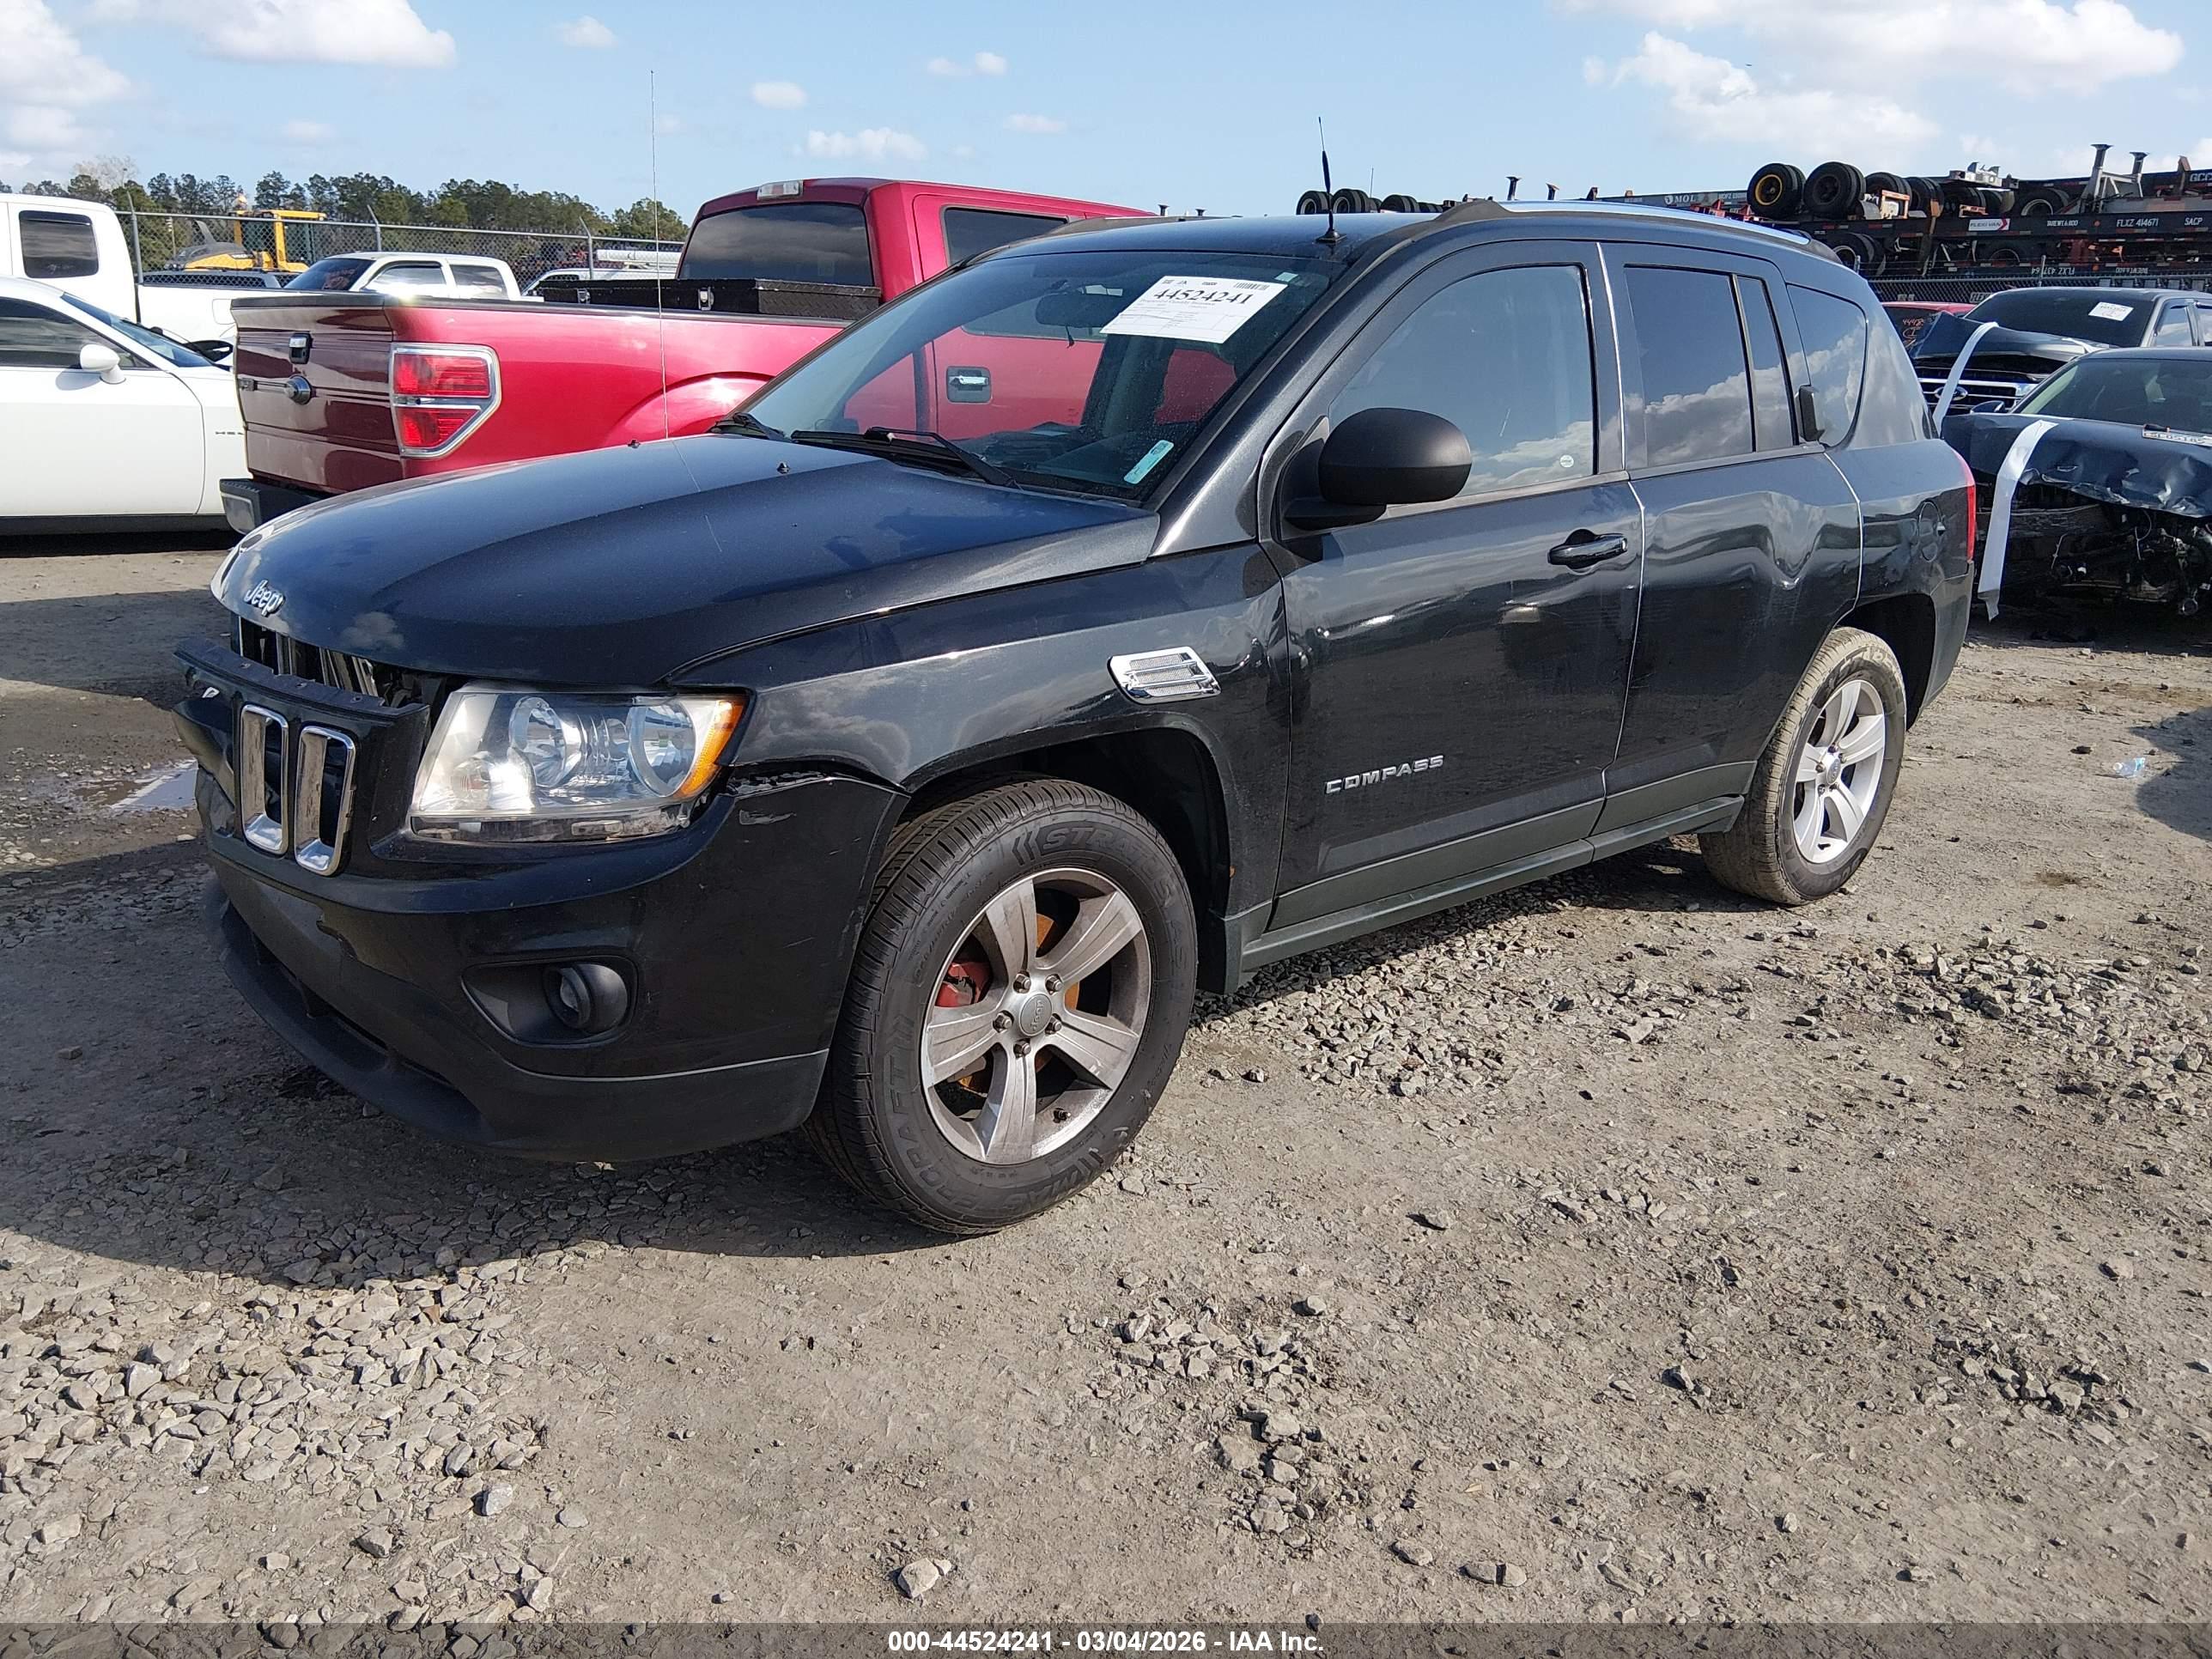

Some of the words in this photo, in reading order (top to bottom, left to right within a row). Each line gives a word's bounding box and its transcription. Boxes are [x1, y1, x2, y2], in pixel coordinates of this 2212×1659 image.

[1674, 194, 1696, 204] MOL
[2116, 218, 2134, 228] FLXZ
[2031, 266, 2056, 275] 43764
[2057, 266, 2075, 275] FLXZ
[1155, 289, 1254, 304] 44524241
[243, 579, 284, 617] Jeep
[1326, 755, 1444, 794] COMPASS
